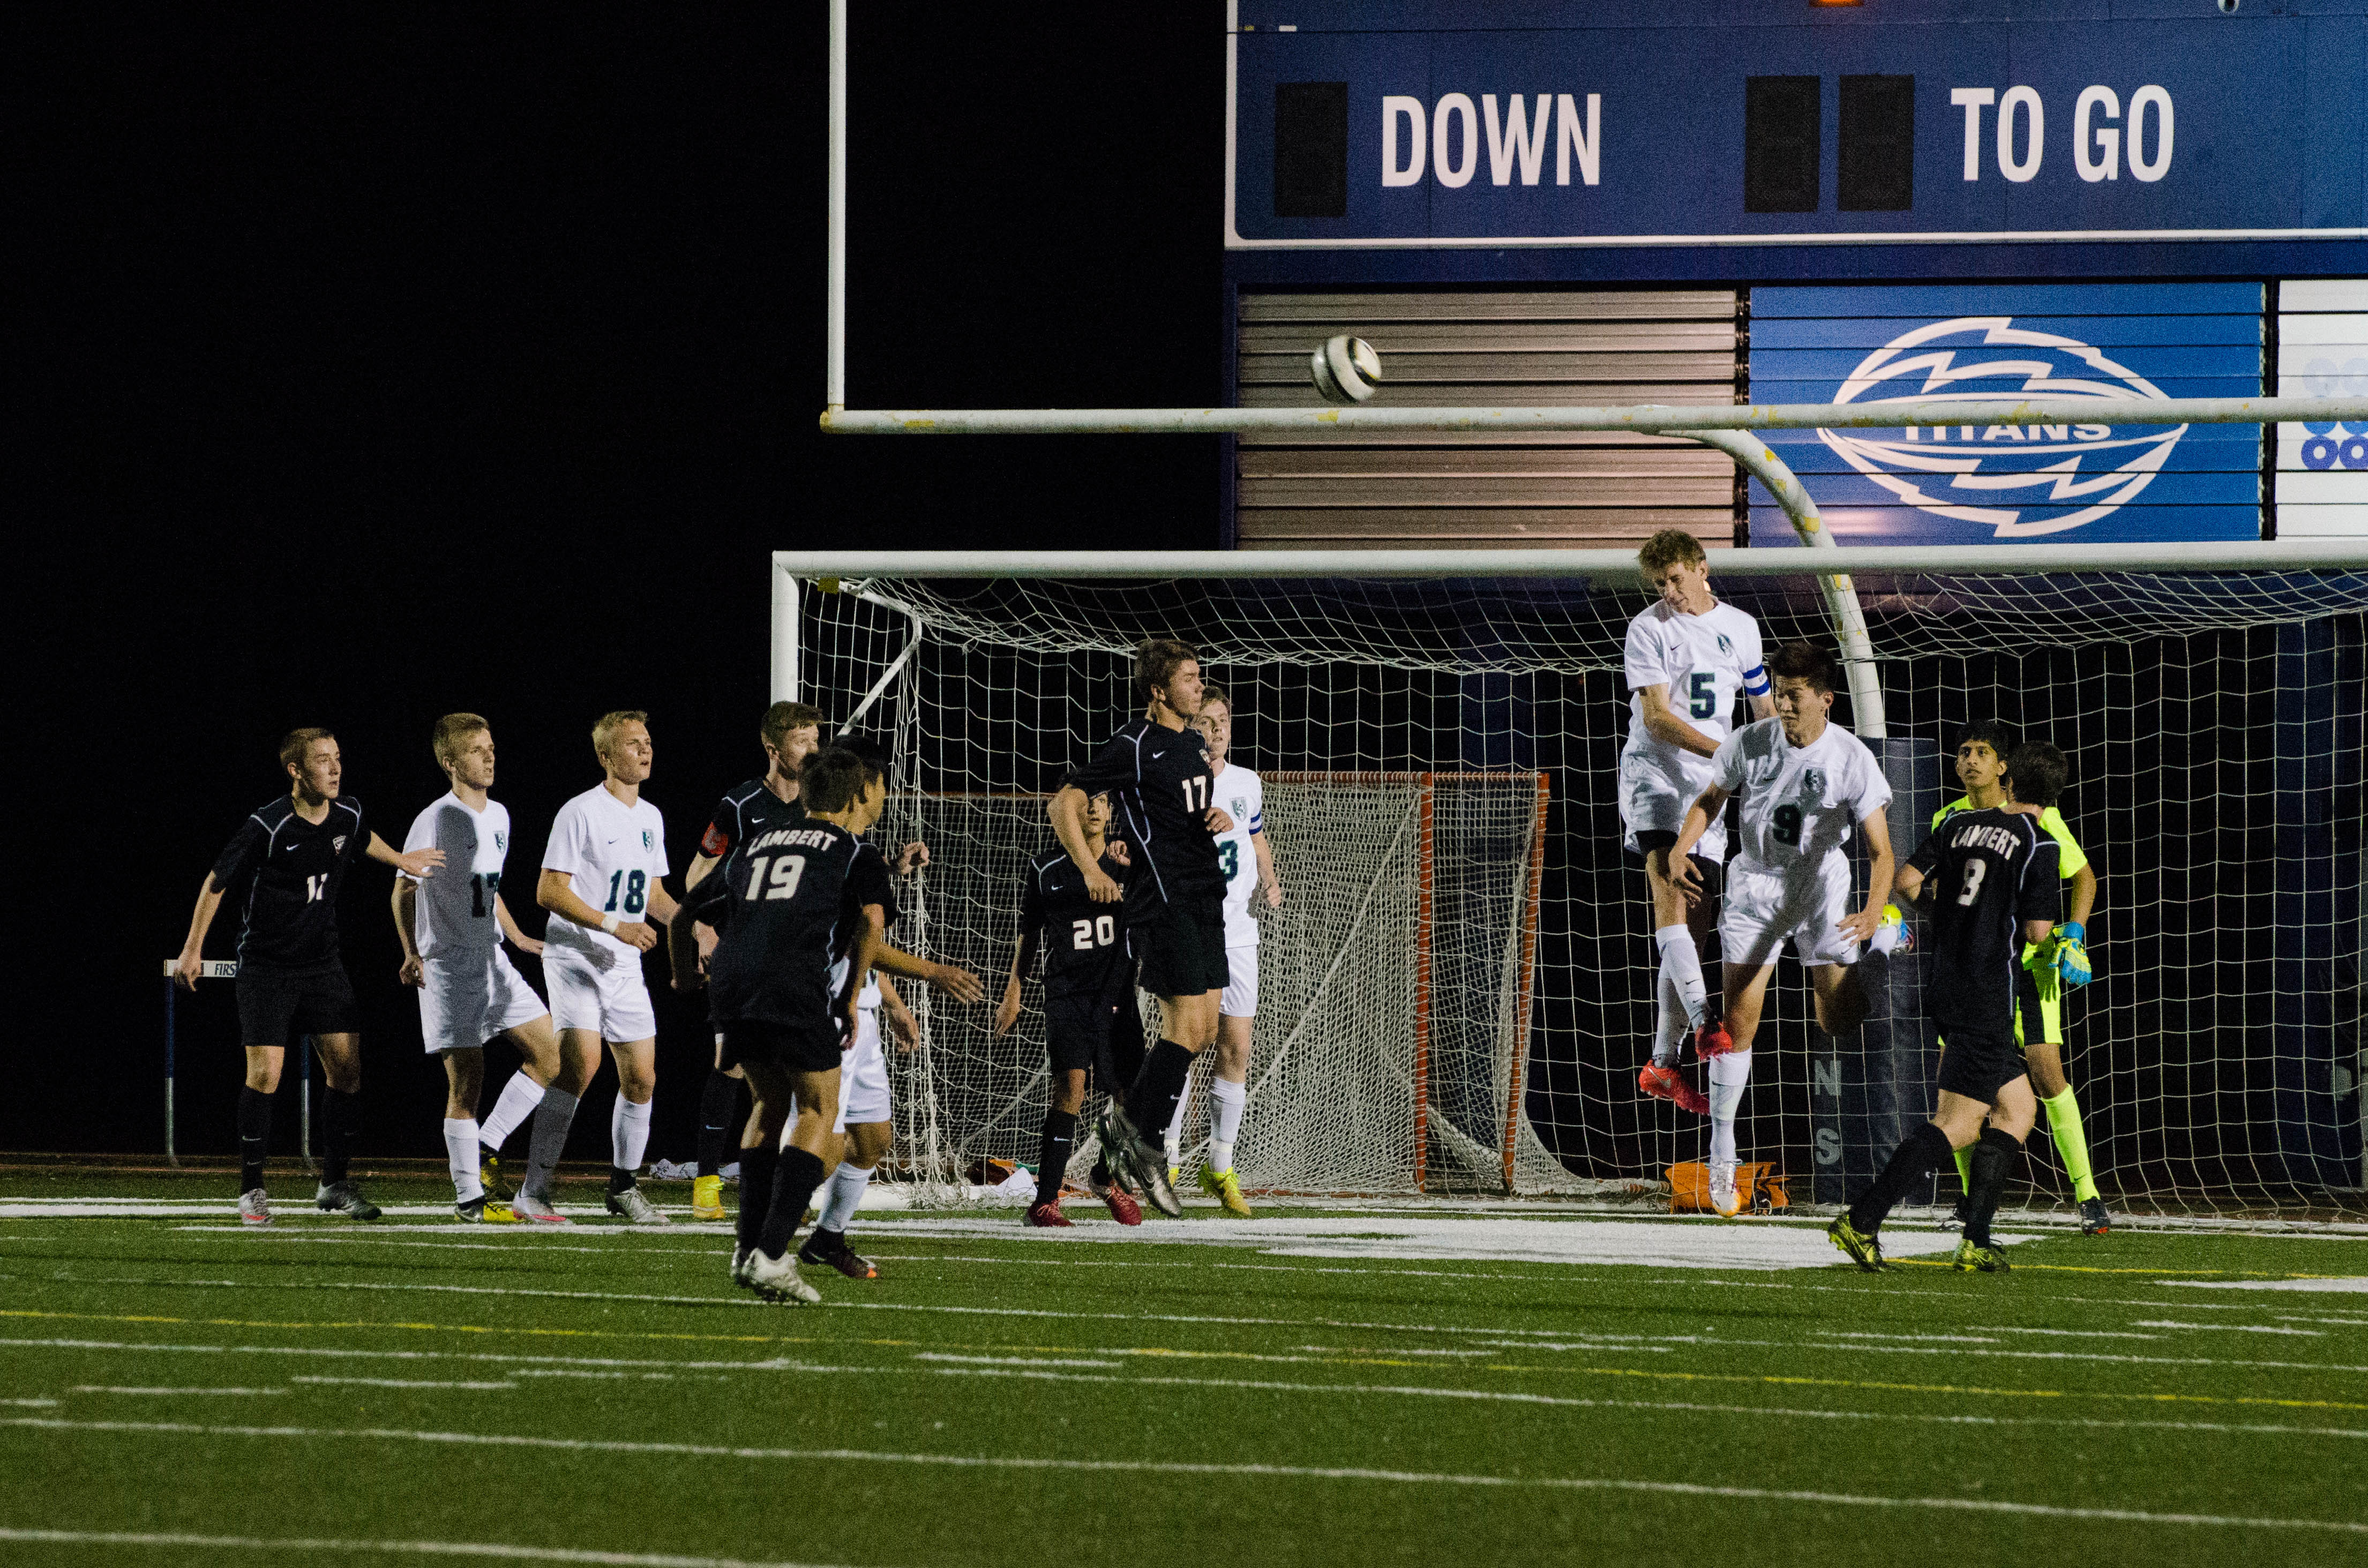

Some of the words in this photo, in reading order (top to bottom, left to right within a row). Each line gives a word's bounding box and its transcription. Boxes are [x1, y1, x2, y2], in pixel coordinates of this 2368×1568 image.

[1381, 92, 1602, 189] DOWN
[1952, 85, 2044, 183] TO
[2073, 84, 2174, 183] GO
[1689, 672, 1716, 720] 5
[1181, 775, 1207, 814] 17
[746, 829, 839, 858] LAMBERT
[1773, 805, 1802, 846] 9
[604, 868, 646, 914] 18
[745, 854, 806, 901] 19
[1073, 915, 1114, 950] 20
